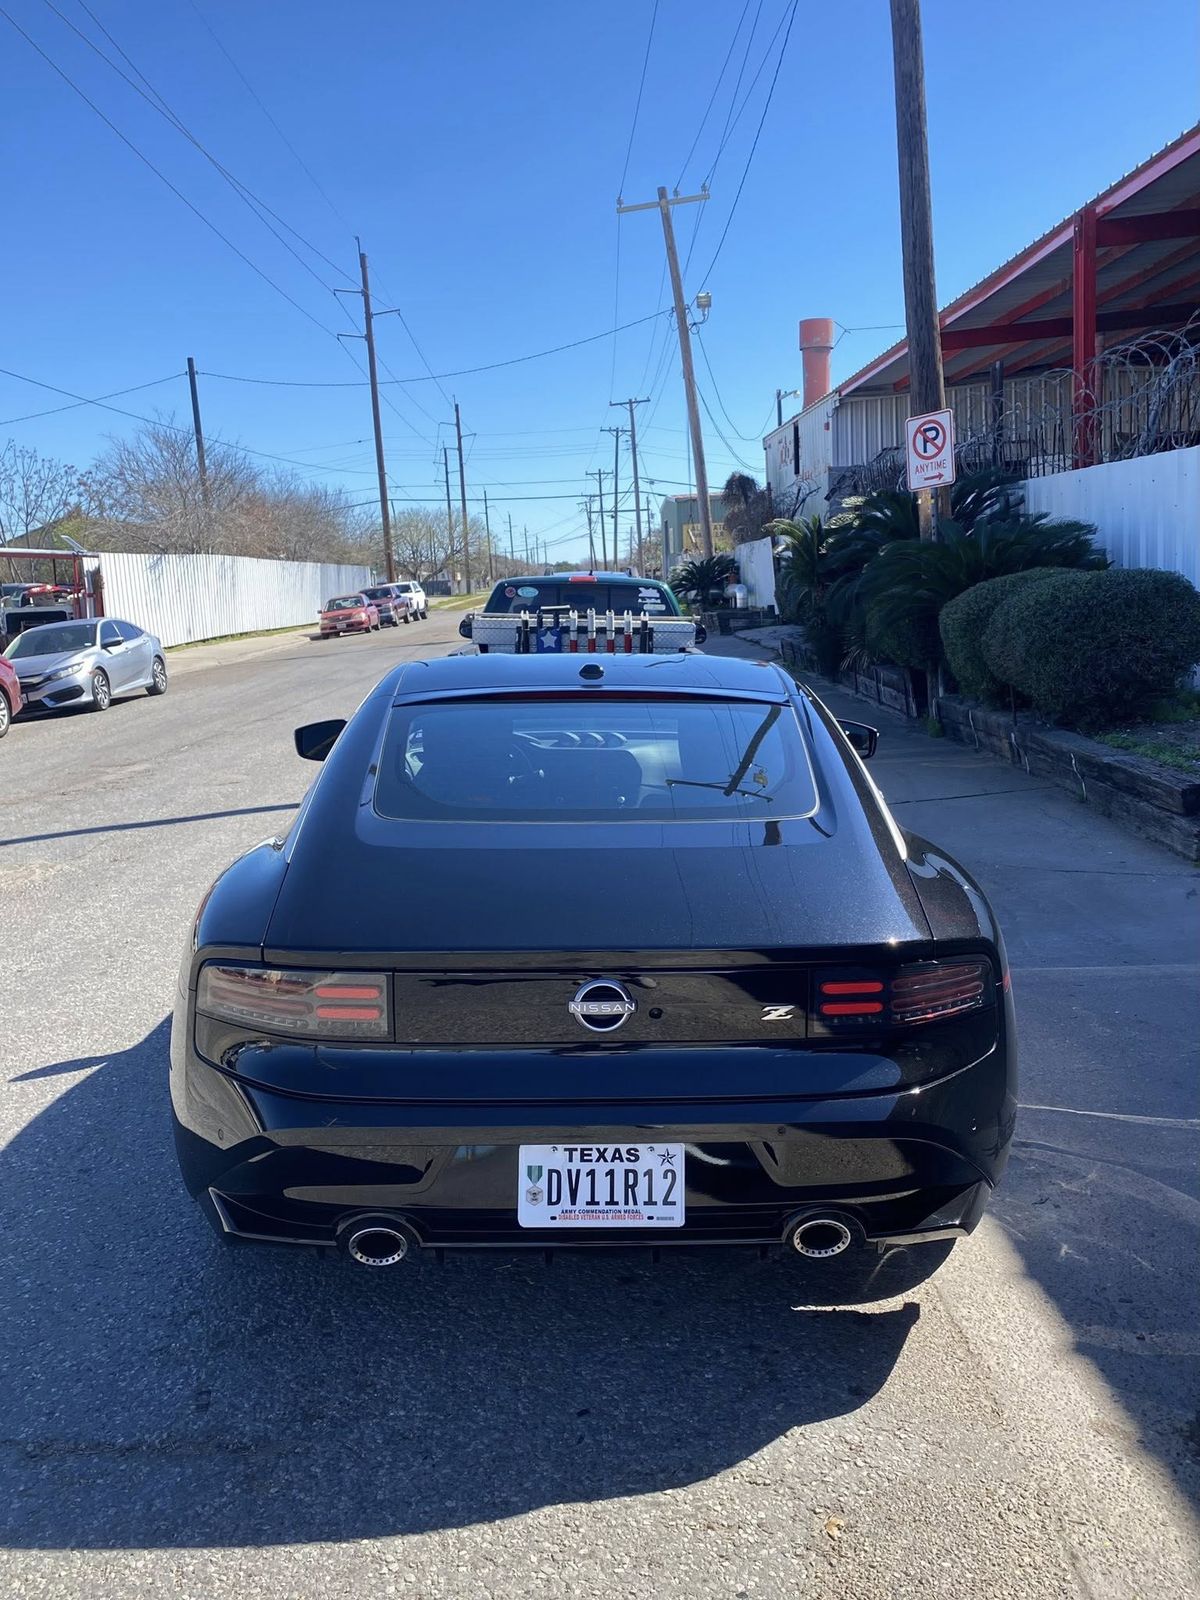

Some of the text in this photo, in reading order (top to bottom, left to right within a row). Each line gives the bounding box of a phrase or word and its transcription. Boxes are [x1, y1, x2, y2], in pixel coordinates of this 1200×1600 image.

[915, 459, 947, 474] ANYTIME
[571, 1003, 635, 1012] NISSAN
[761, 1005, 796, 1021] Z
[563, 1147, 640, 1163] TEXAS
[547, 1168, 677, 1206] DV11R12
